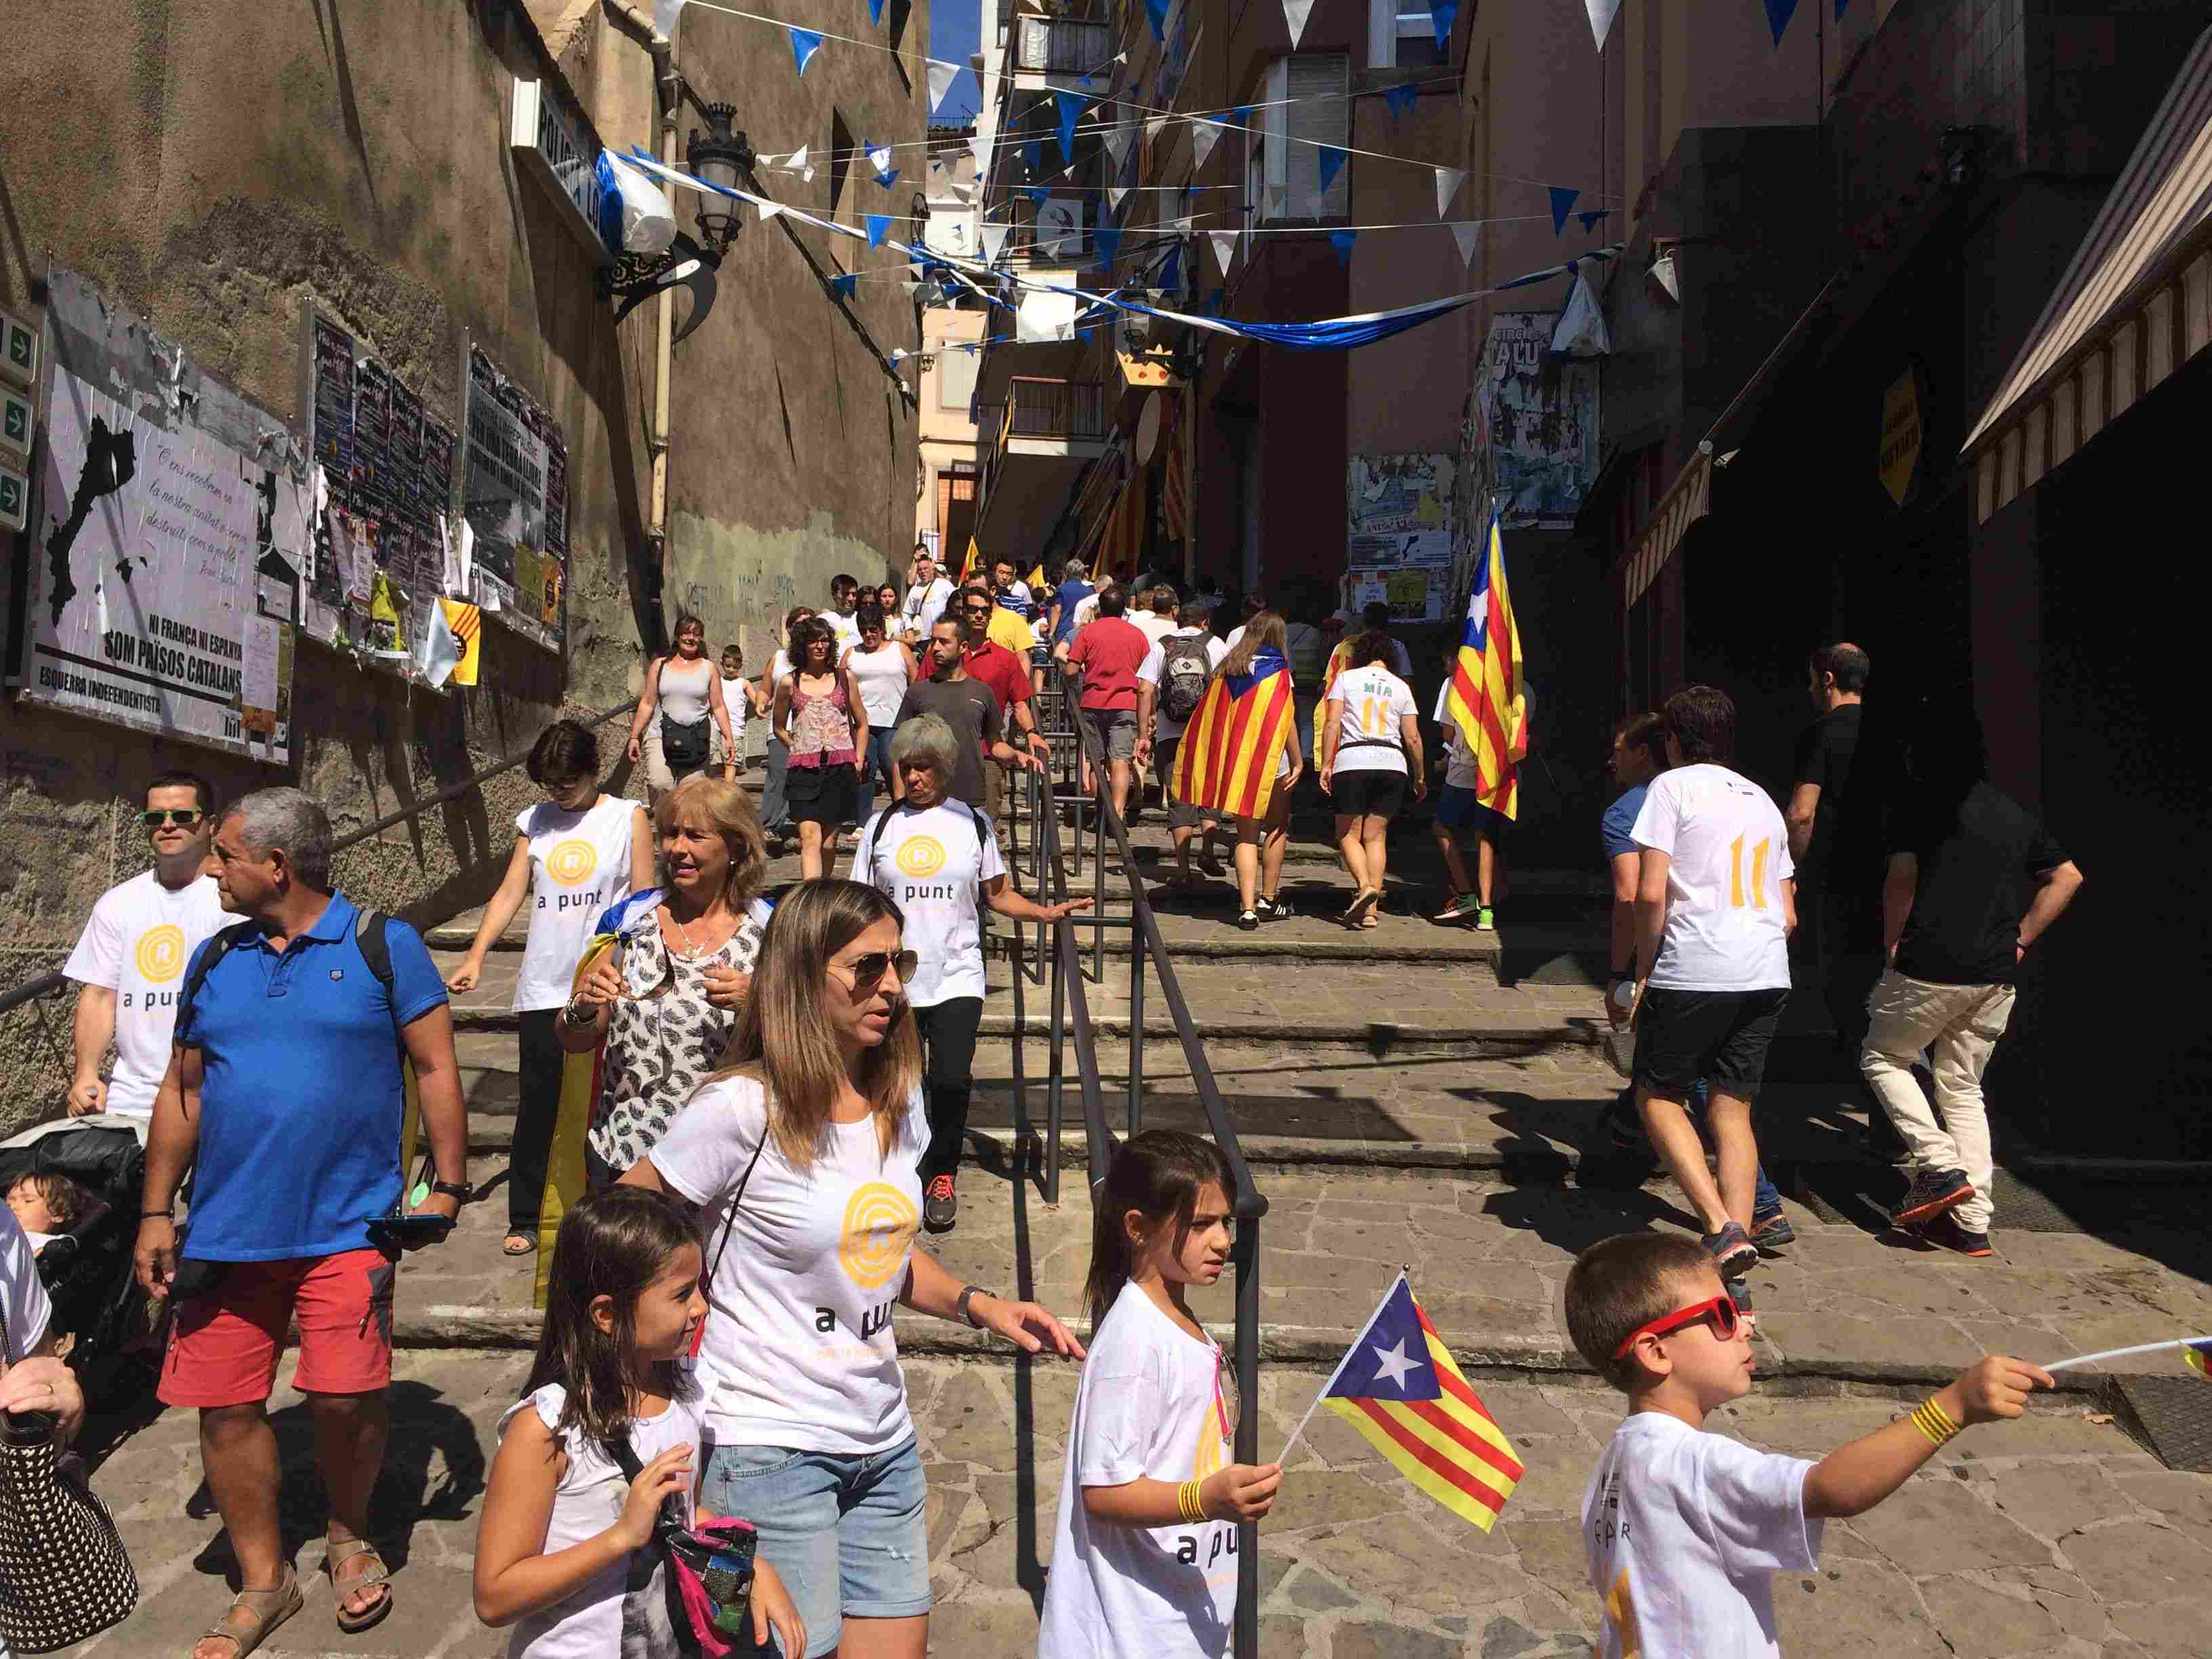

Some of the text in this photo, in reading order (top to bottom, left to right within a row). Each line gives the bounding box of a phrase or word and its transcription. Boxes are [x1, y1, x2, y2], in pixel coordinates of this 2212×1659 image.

[161, 491, 192, 512] nostra
[149, 613, 243, 662] NI FRANÇA NI ESPANYA
[104, 629, 136, 665] SOM
[138, 639, 185, 679] PAÏSOS
[187, 655, 243, 695] CATALANS
[39, 665, 161, 716] ESQUERRA INDEPENDENTISTA
[538, 888, 602, 912] a punt
[905, 884, 954, 903] punt
[123, 993, 132, 1007] a
[815, 1307, 836, 1332] a
[1177, 1535, 1197, 1565] a
